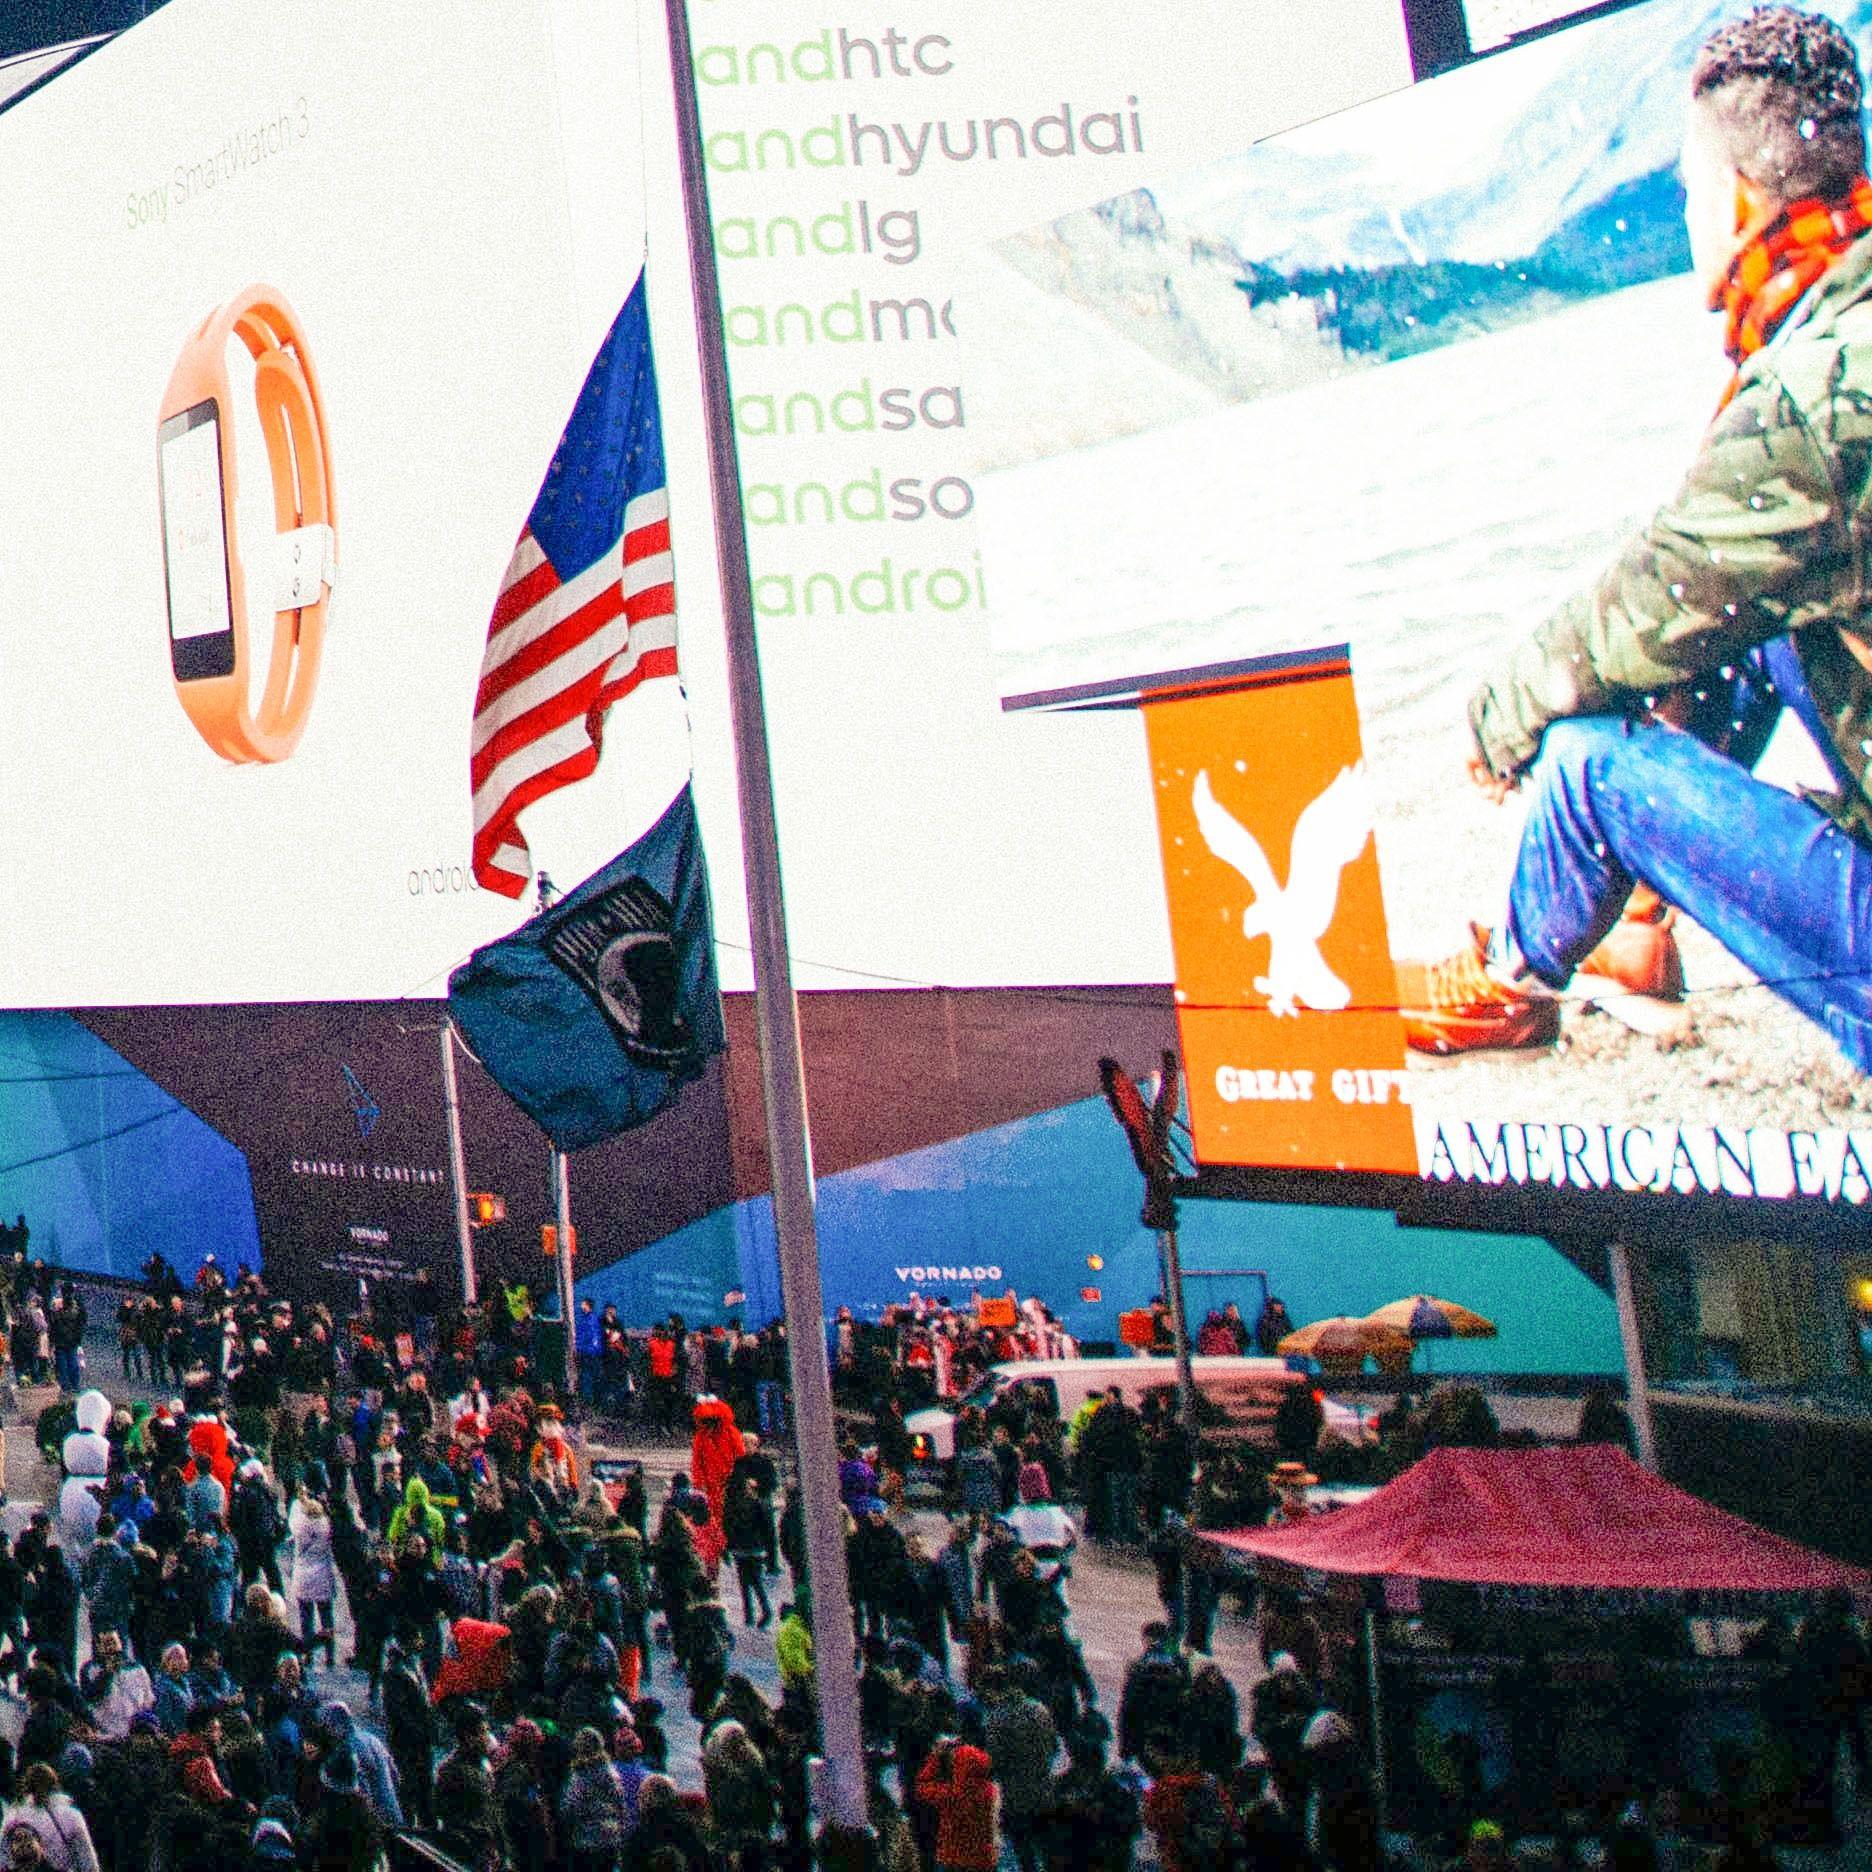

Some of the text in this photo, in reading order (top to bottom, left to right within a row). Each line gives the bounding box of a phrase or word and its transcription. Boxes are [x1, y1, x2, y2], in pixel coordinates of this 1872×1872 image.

[693, 26, 955, 87] andhtc
[702, 95, 1145, 177] andhyundai
[715, 201, 920, 265] andlg
[1215, 1066, 1315, 1103] GREAT
[291, 1159, 444, 1184] CHANGE IS CONSTANT
[1420, 1120, 1757, 1198] AMERICAN
[894, 1265, 1004, 1282] VORNADO
